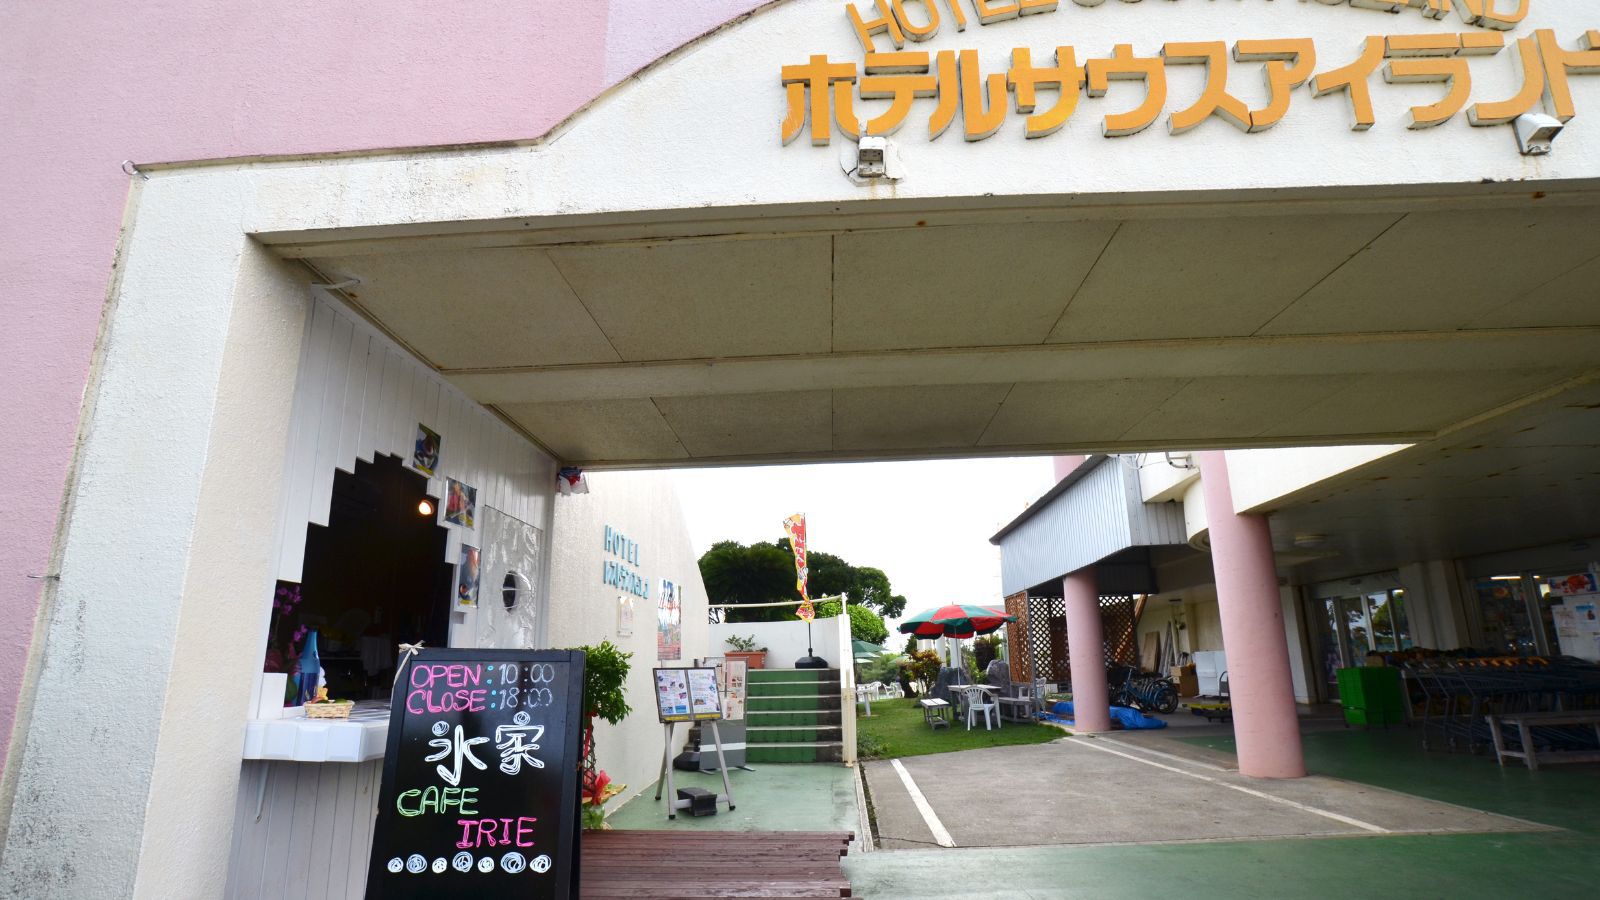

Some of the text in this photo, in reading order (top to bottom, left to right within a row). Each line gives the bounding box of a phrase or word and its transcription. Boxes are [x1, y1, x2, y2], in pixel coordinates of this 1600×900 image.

[603, 524, 640, 567] HOTEL
[397, 785, 480, 816] CAFE
[456, 817, 537, 848] IRIE
